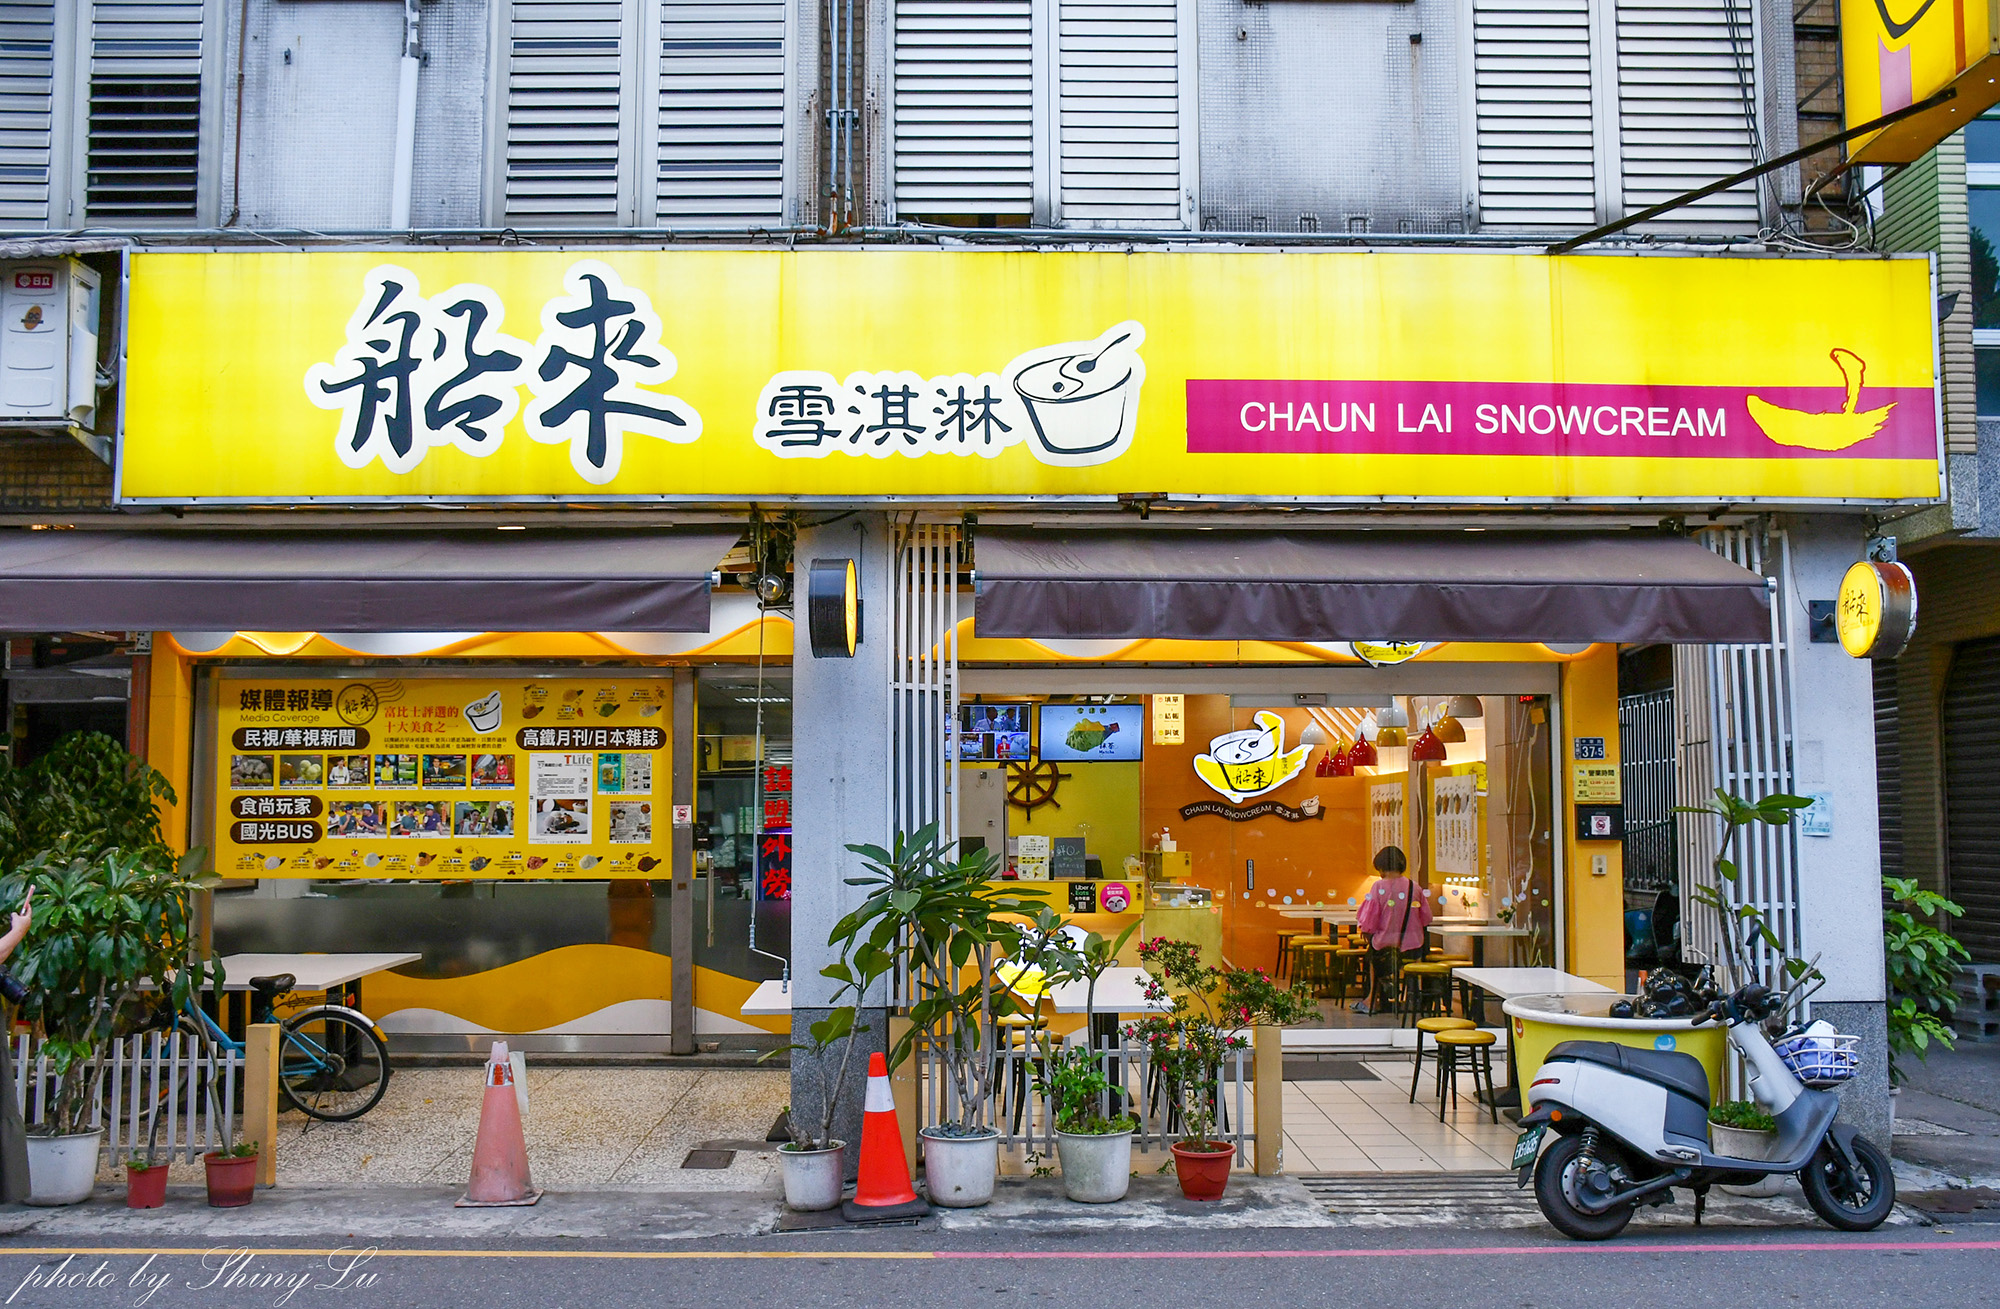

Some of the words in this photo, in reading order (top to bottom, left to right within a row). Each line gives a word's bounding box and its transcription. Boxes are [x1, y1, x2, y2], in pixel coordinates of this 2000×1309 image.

[319, 273, 688, 469] 船來
[765, 384, 1013, 447] 雪淇淋
[1240, 402, 1376, 433] CHAUN
[1398, 403, 1452, 434] LAI
[1475, 404, 1726, 438] SNOWCREAM
[240, 689, 333, 712] 媒體報導
[240, 714, 270, 722] Media
[273, 714, 320, 723] Coverage
[384, 706, 459, 719] 富比士評選的
[384, 721, 459, 733] 十大美食之一
[244, 729, 356, 747] 民視/華視新聞
[523, 728, 659, 747] 高鐵月刊/日本雜誌
[1232, 767, 1269, 789] 船來
[240, 797, 312, 816] 食尚玩家
[1184, 804, 1211, 816] CHAUN
[1212, 805, 1223, 813] LAI
[1224, 804, 1272, 819] SNOWCREAM
[240, 823, 314, 841] 國光BUS
